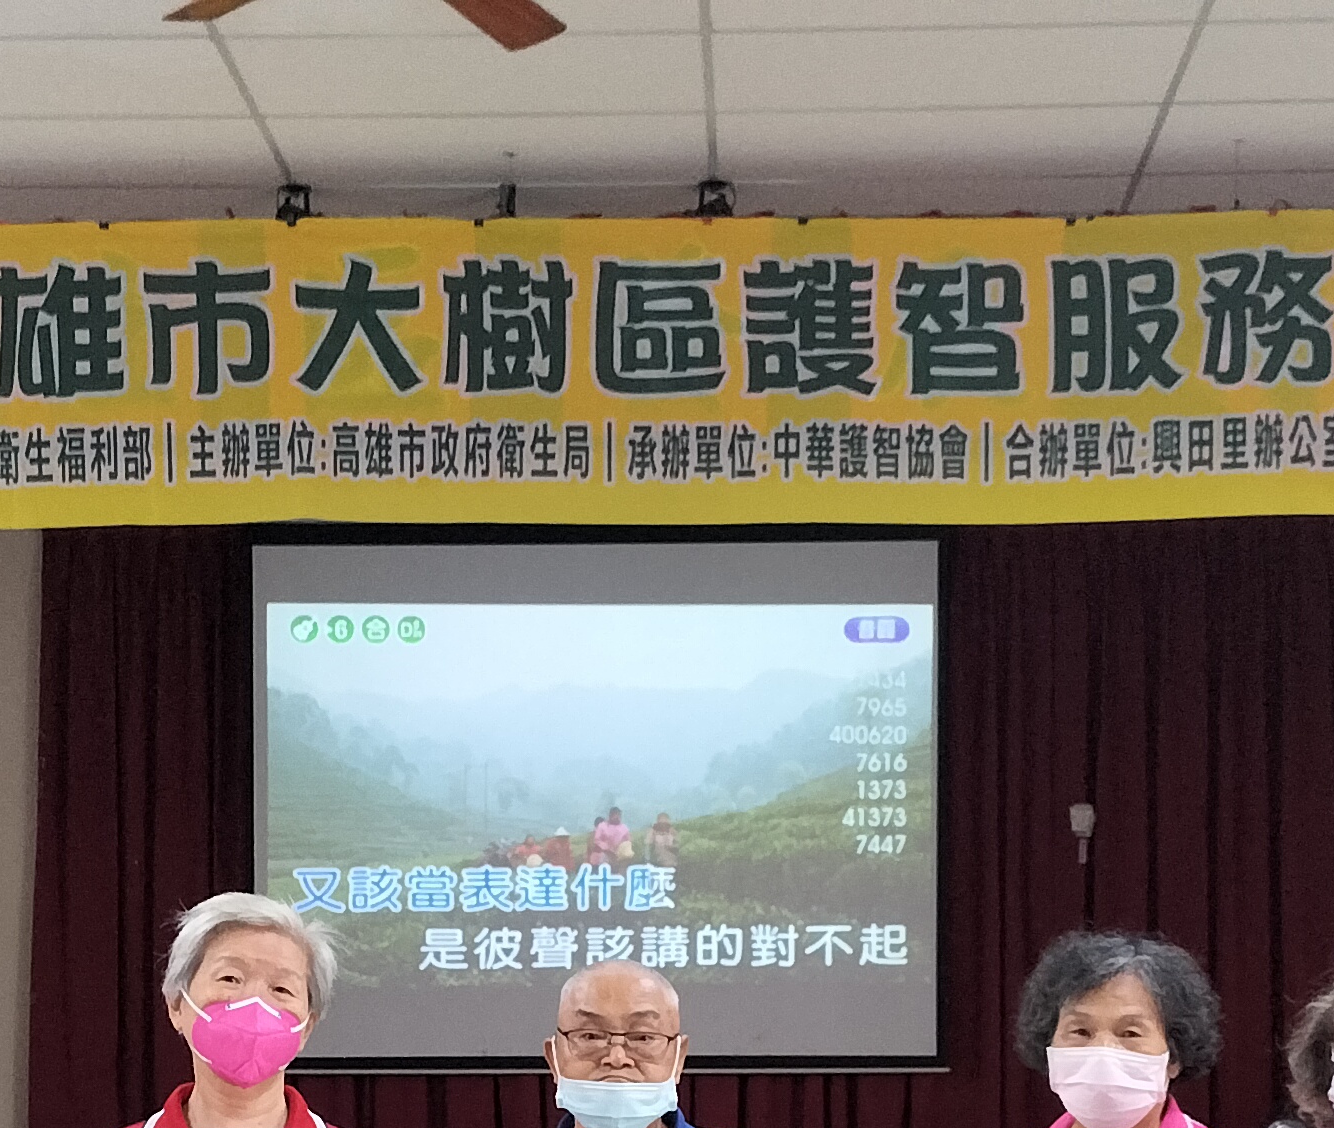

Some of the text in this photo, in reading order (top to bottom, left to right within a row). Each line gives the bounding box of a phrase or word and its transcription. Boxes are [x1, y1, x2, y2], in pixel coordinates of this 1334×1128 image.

[189, 419, 591, 482] 主辦單位:高雄市政府衛生局
[628, 422, 968, 481] 承辦單位:中華護智協會
[856, 697, 907, 717] 7965
[829, 725, 907, 745] 400620
[857, 752, 908, 772] 7616
[857, 779, 907, 800] 1373
[842, 807, 907, 827] 41373
[855, 834, 907, 854] 7447
[293, 866, 676, 912] 又該當表達什麼
[419, 924, 908, 971] 是彼聲該講的對不起
